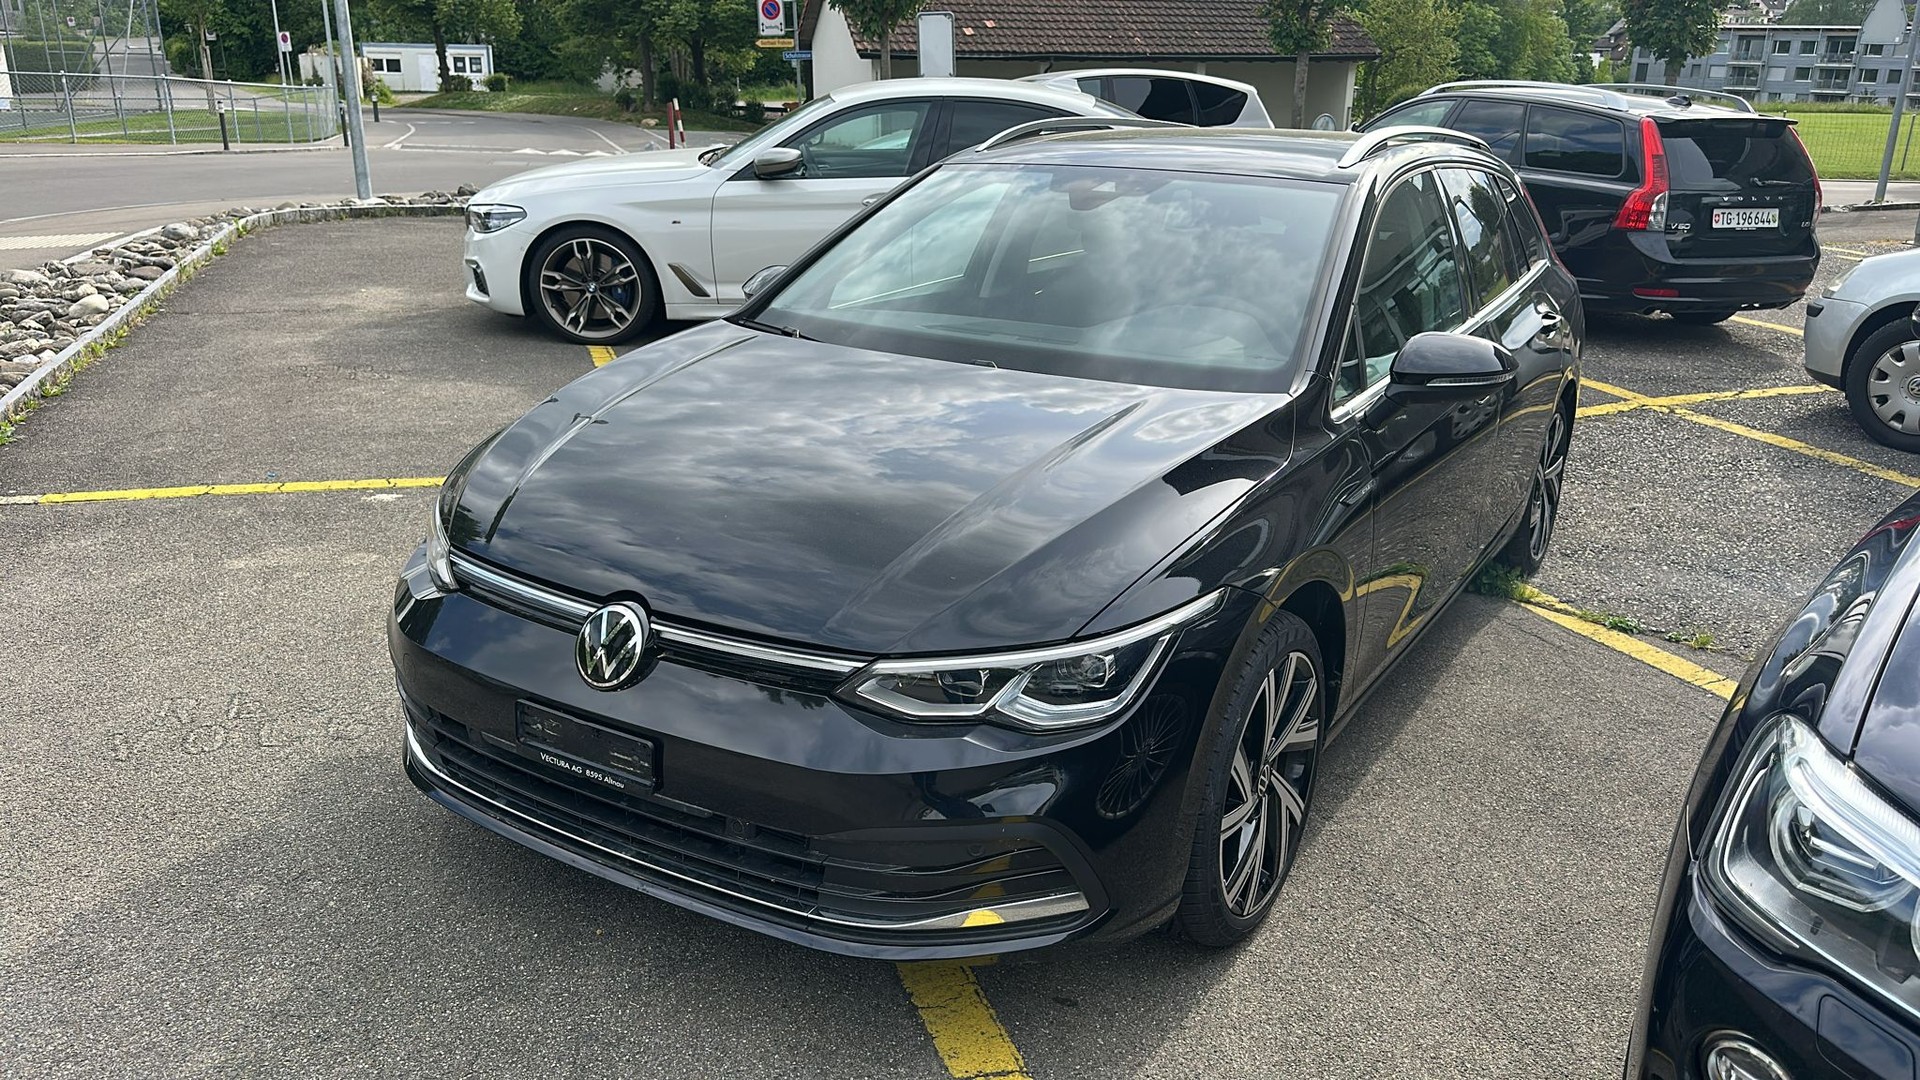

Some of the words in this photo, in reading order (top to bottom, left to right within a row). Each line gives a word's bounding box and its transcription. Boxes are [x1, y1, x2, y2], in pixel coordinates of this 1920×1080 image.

[540, 752, 571, 770] VECTURA
[571, 764, 583, 774] AG
[585, 768, 603, 781] 8595
[603, 775, 625, 789] Altnau
